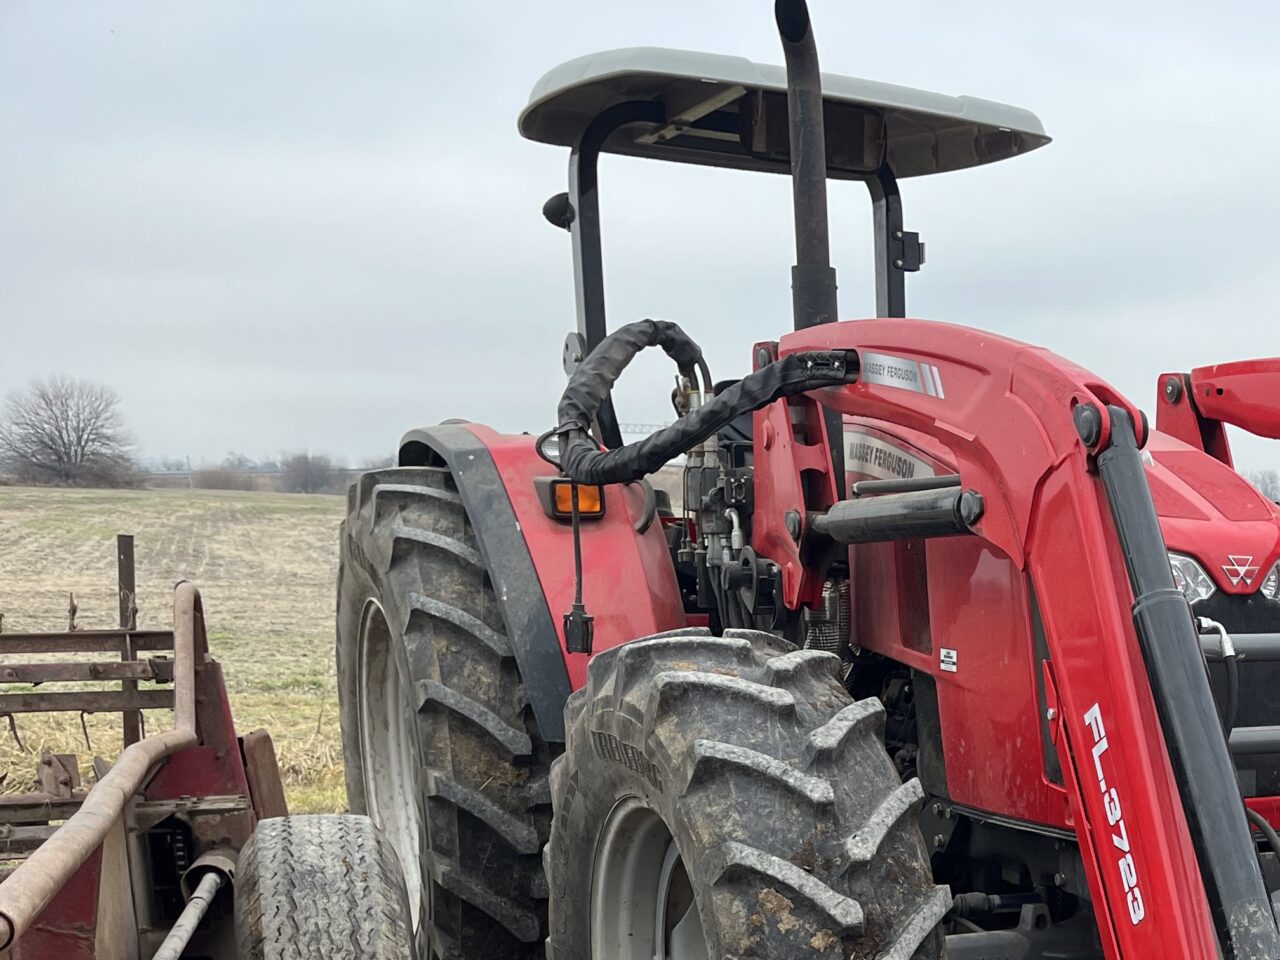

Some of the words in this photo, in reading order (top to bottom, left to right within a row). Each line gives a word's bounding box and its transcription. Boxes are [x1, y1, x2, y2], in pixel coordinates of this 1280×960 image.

[887, 365, 918, 383] FERGUSON
[849, 442, 875, 464] MASSEY
[874, 447, 915, 478] FERGUSON
